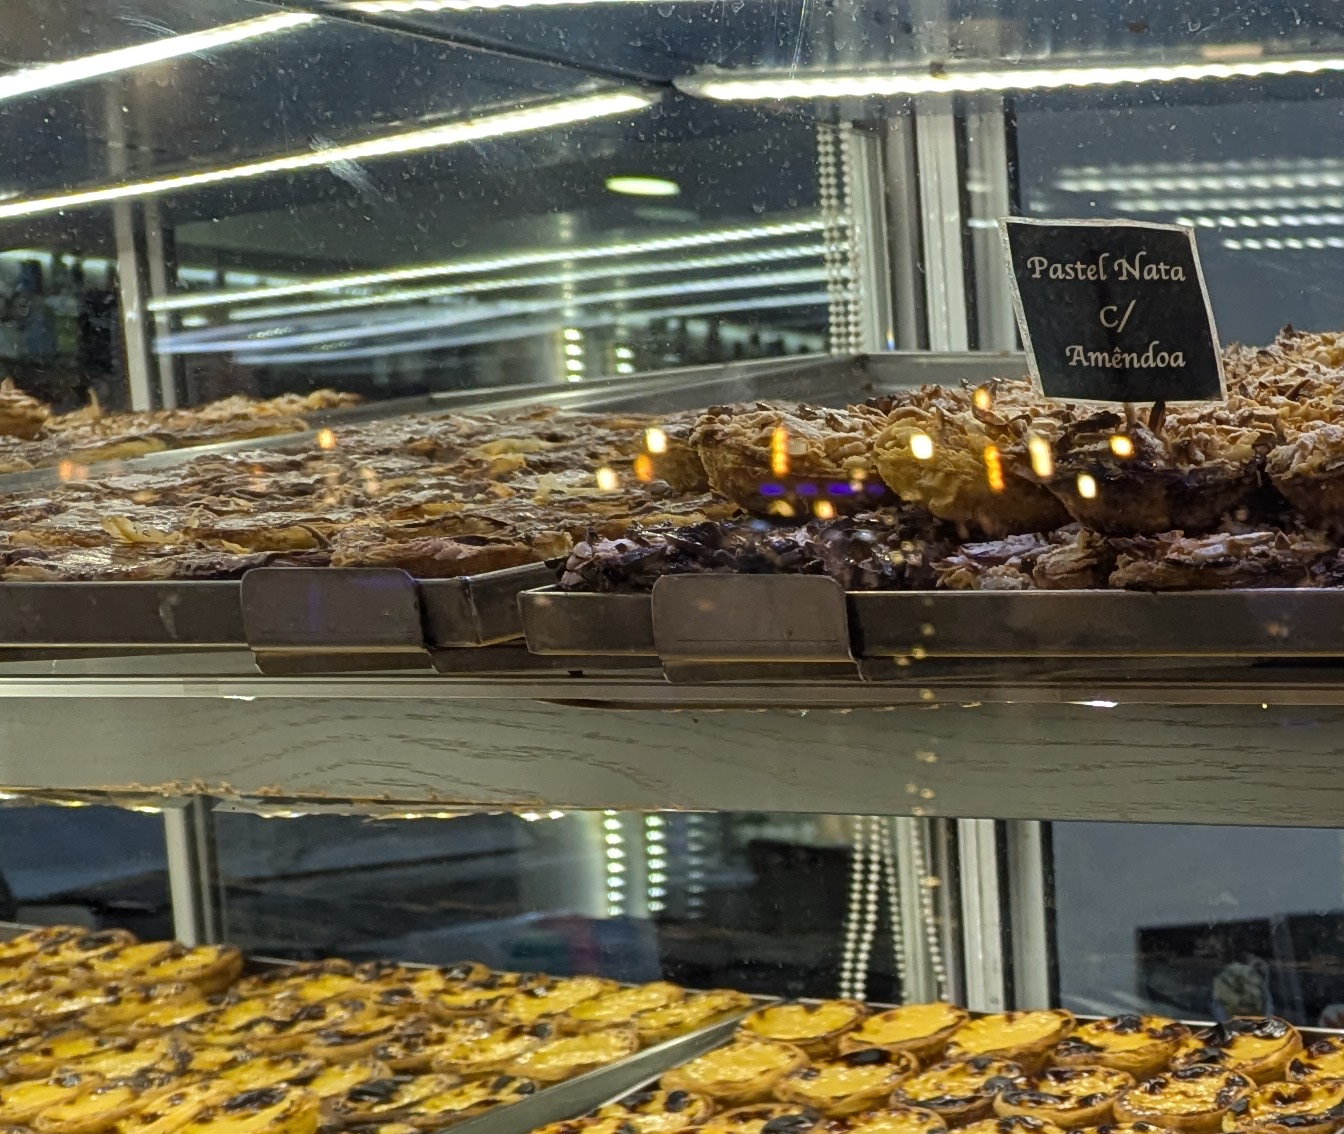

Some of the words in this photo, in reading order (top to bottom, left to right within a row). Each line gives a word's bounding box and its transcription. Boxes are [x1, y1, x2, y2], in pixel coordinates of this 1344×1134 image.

[1027, 253, 1109, 281] Pastel
[1114, 252, 1186, 281] Nata
[1066, 341, 1186, 369] Amêndoa
